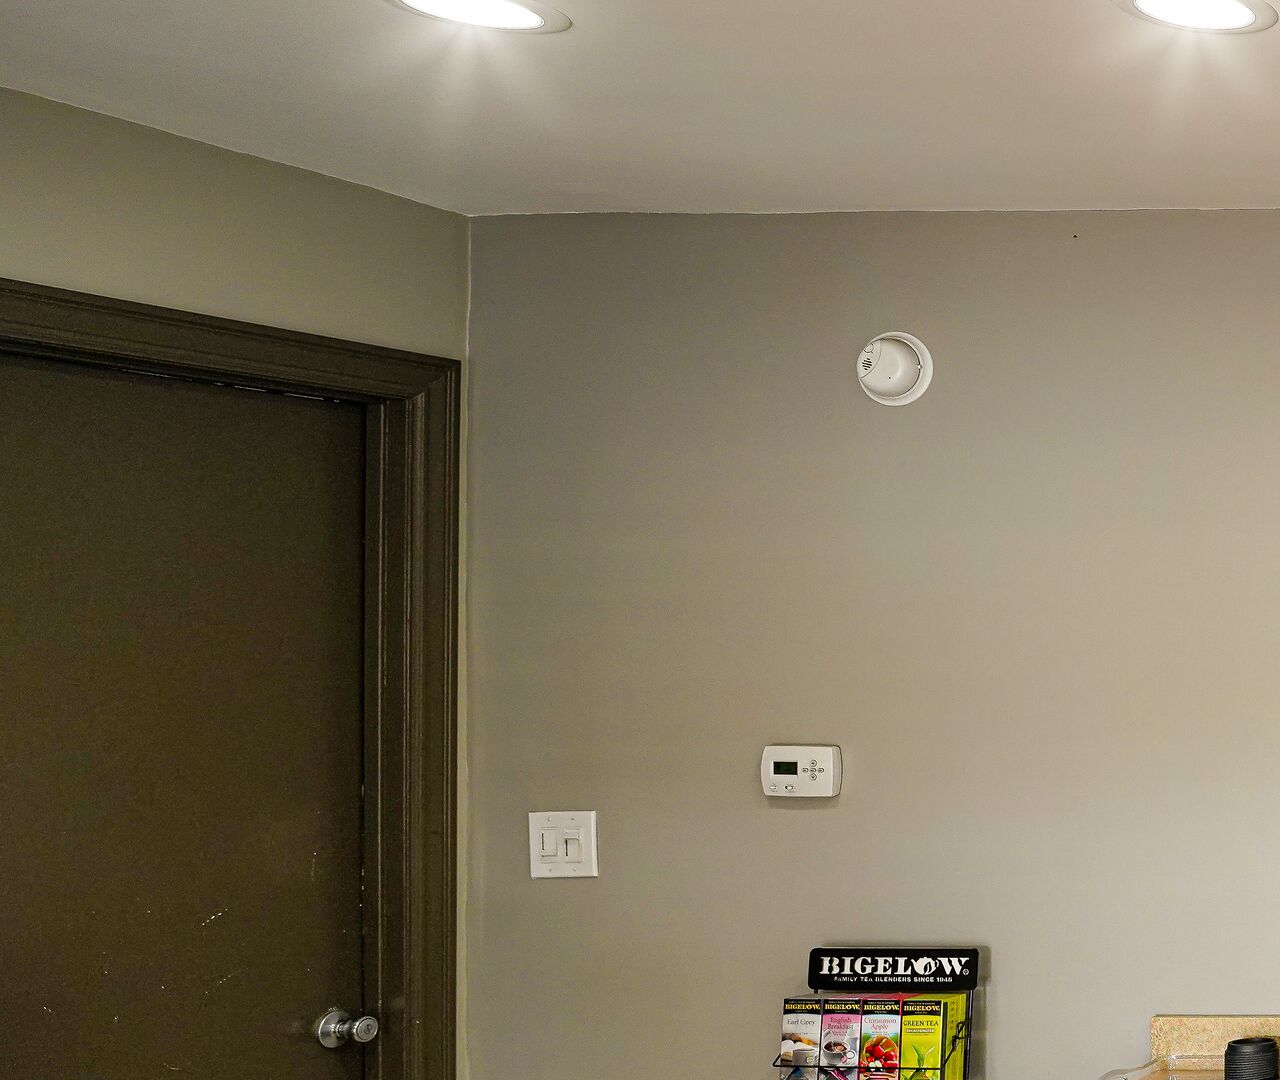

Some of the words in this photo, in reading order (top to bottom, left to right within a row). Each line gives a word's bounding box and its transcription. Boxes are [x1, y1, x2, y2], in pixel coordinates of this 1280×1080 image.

[820, 956, 970, 976] BIGELOW
[800, 1018, 815, 1026] Grey
[830, 1016, 852, 1024] English
